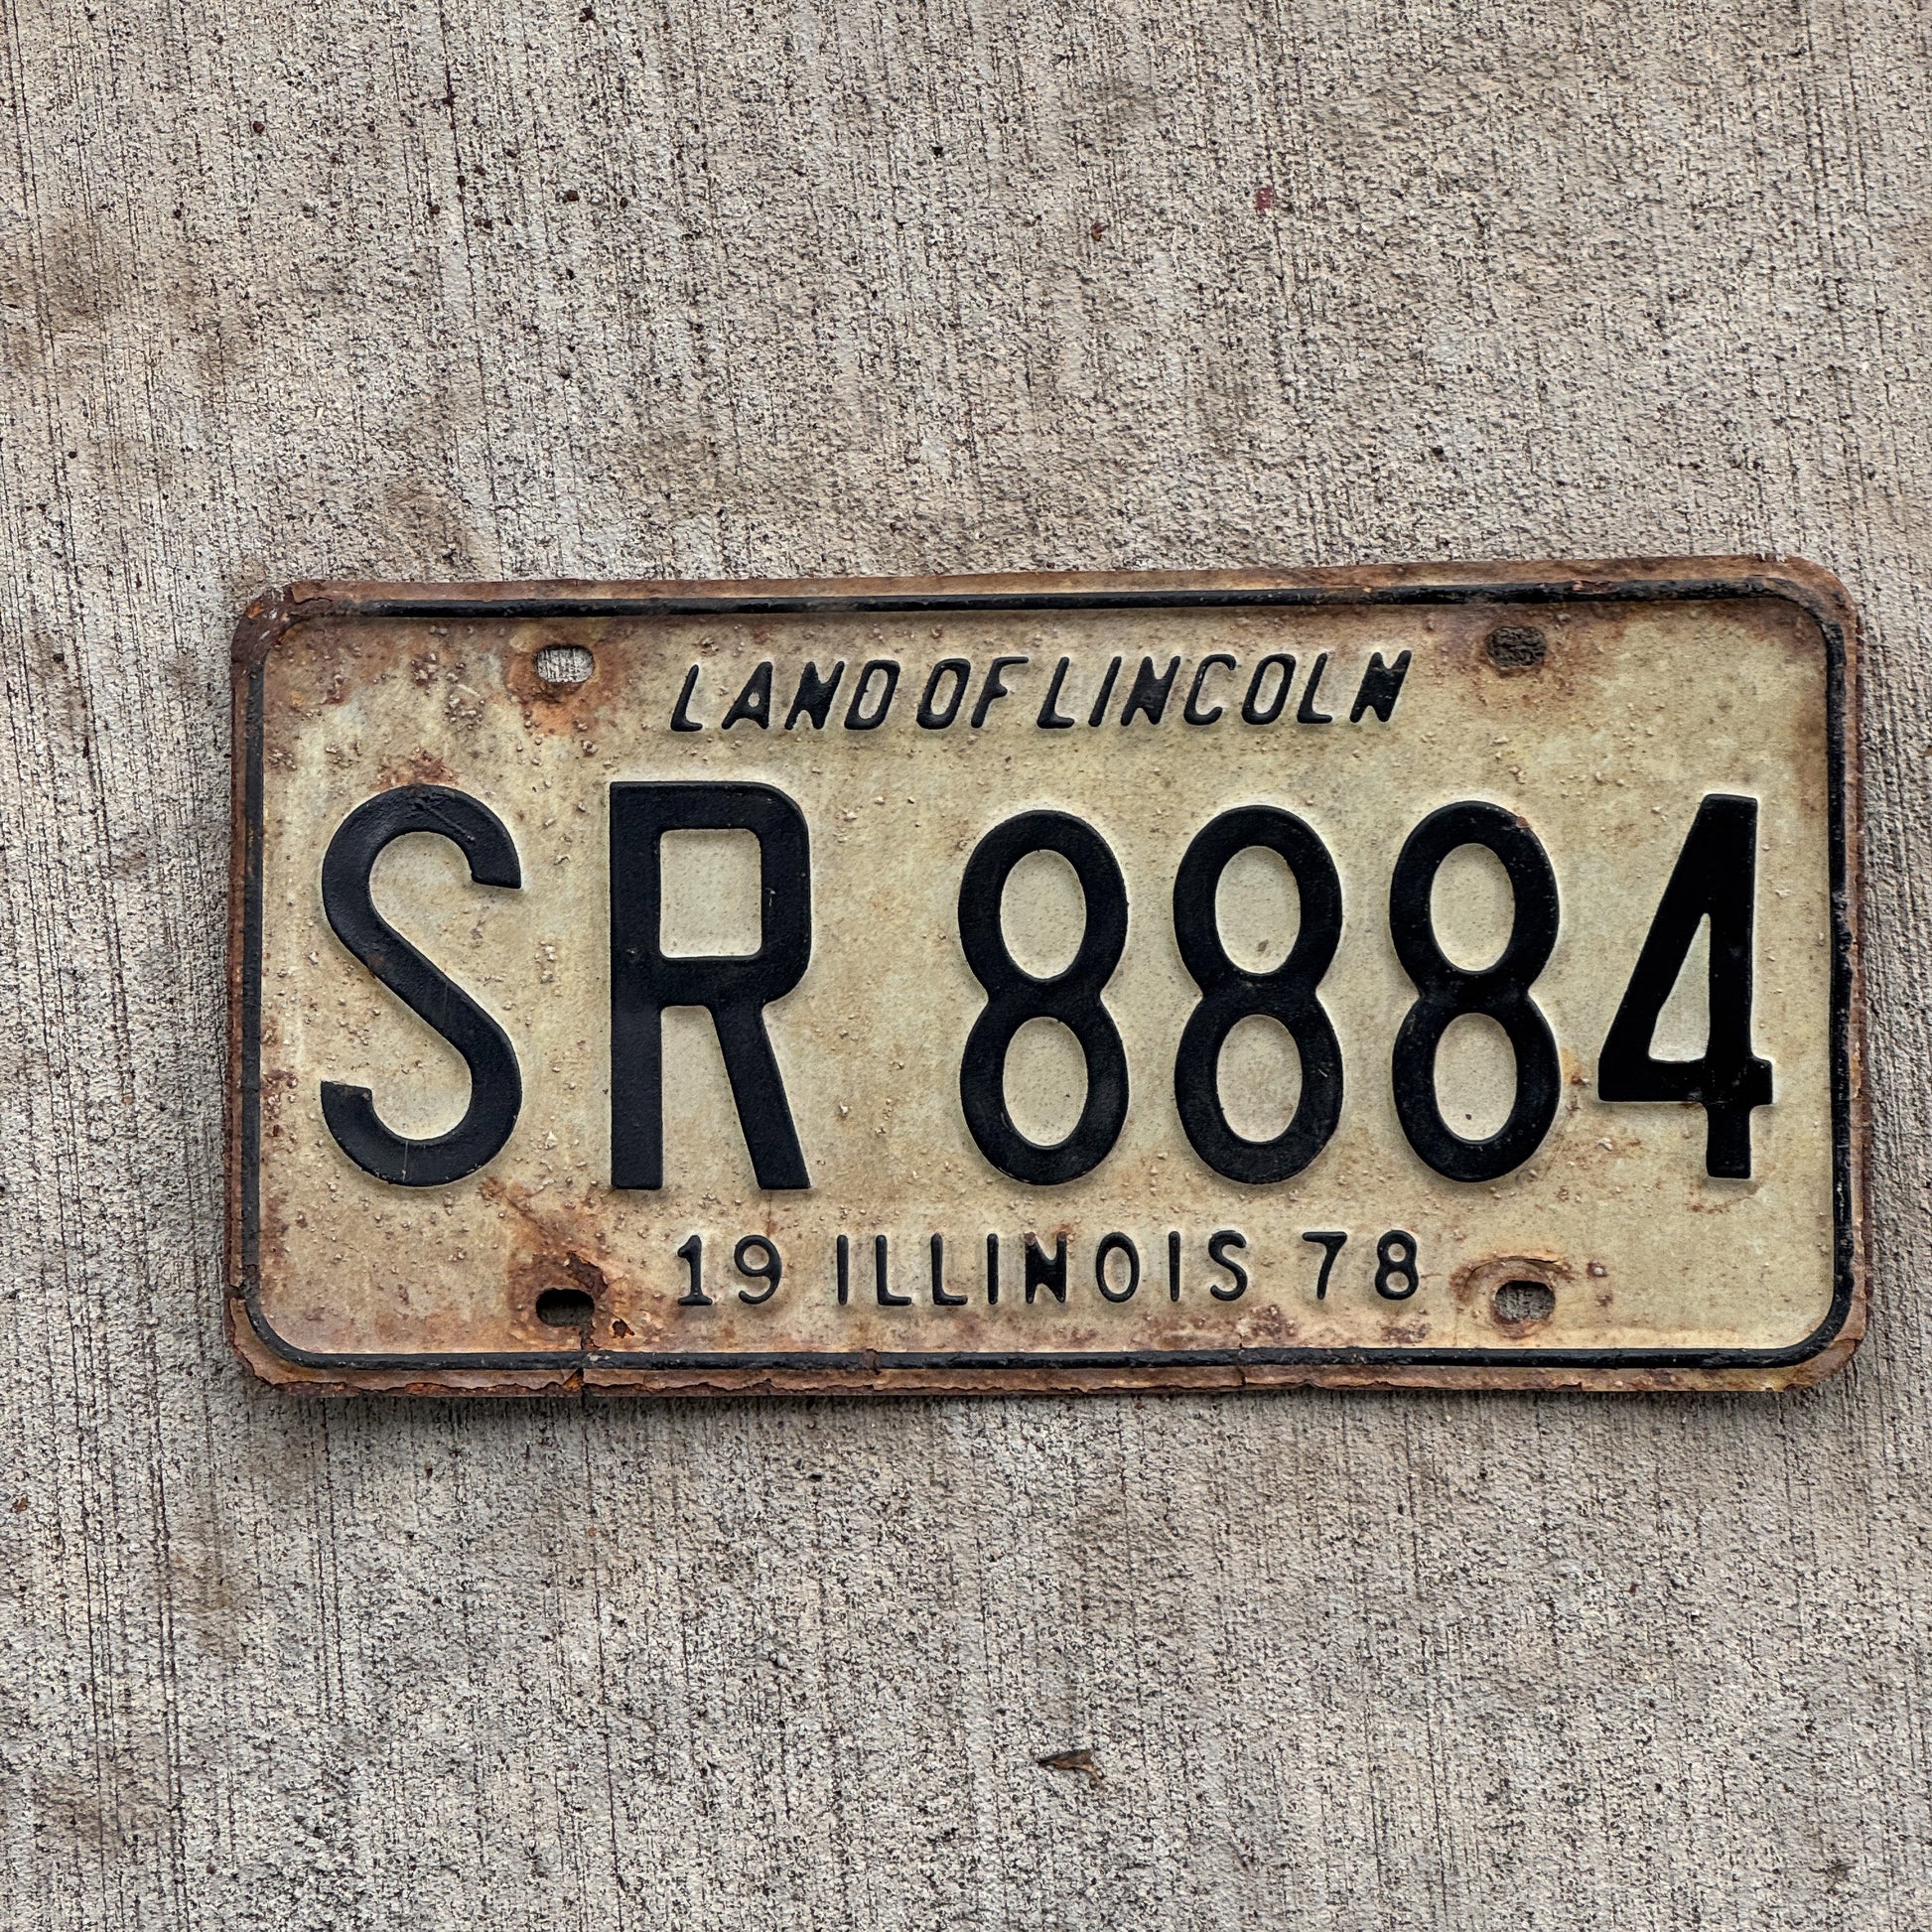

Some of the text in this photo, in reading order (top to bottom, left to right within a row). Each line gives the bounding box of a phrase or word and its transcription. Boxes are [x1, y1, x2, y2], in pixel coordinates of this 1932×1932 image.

[671, 649, 1413, 733] LAND OF LINCOLN
[321, 780, 1774, 1191] SR 8884
[679, 1229, 1420, 1307] 19 ILLINOIS 78
